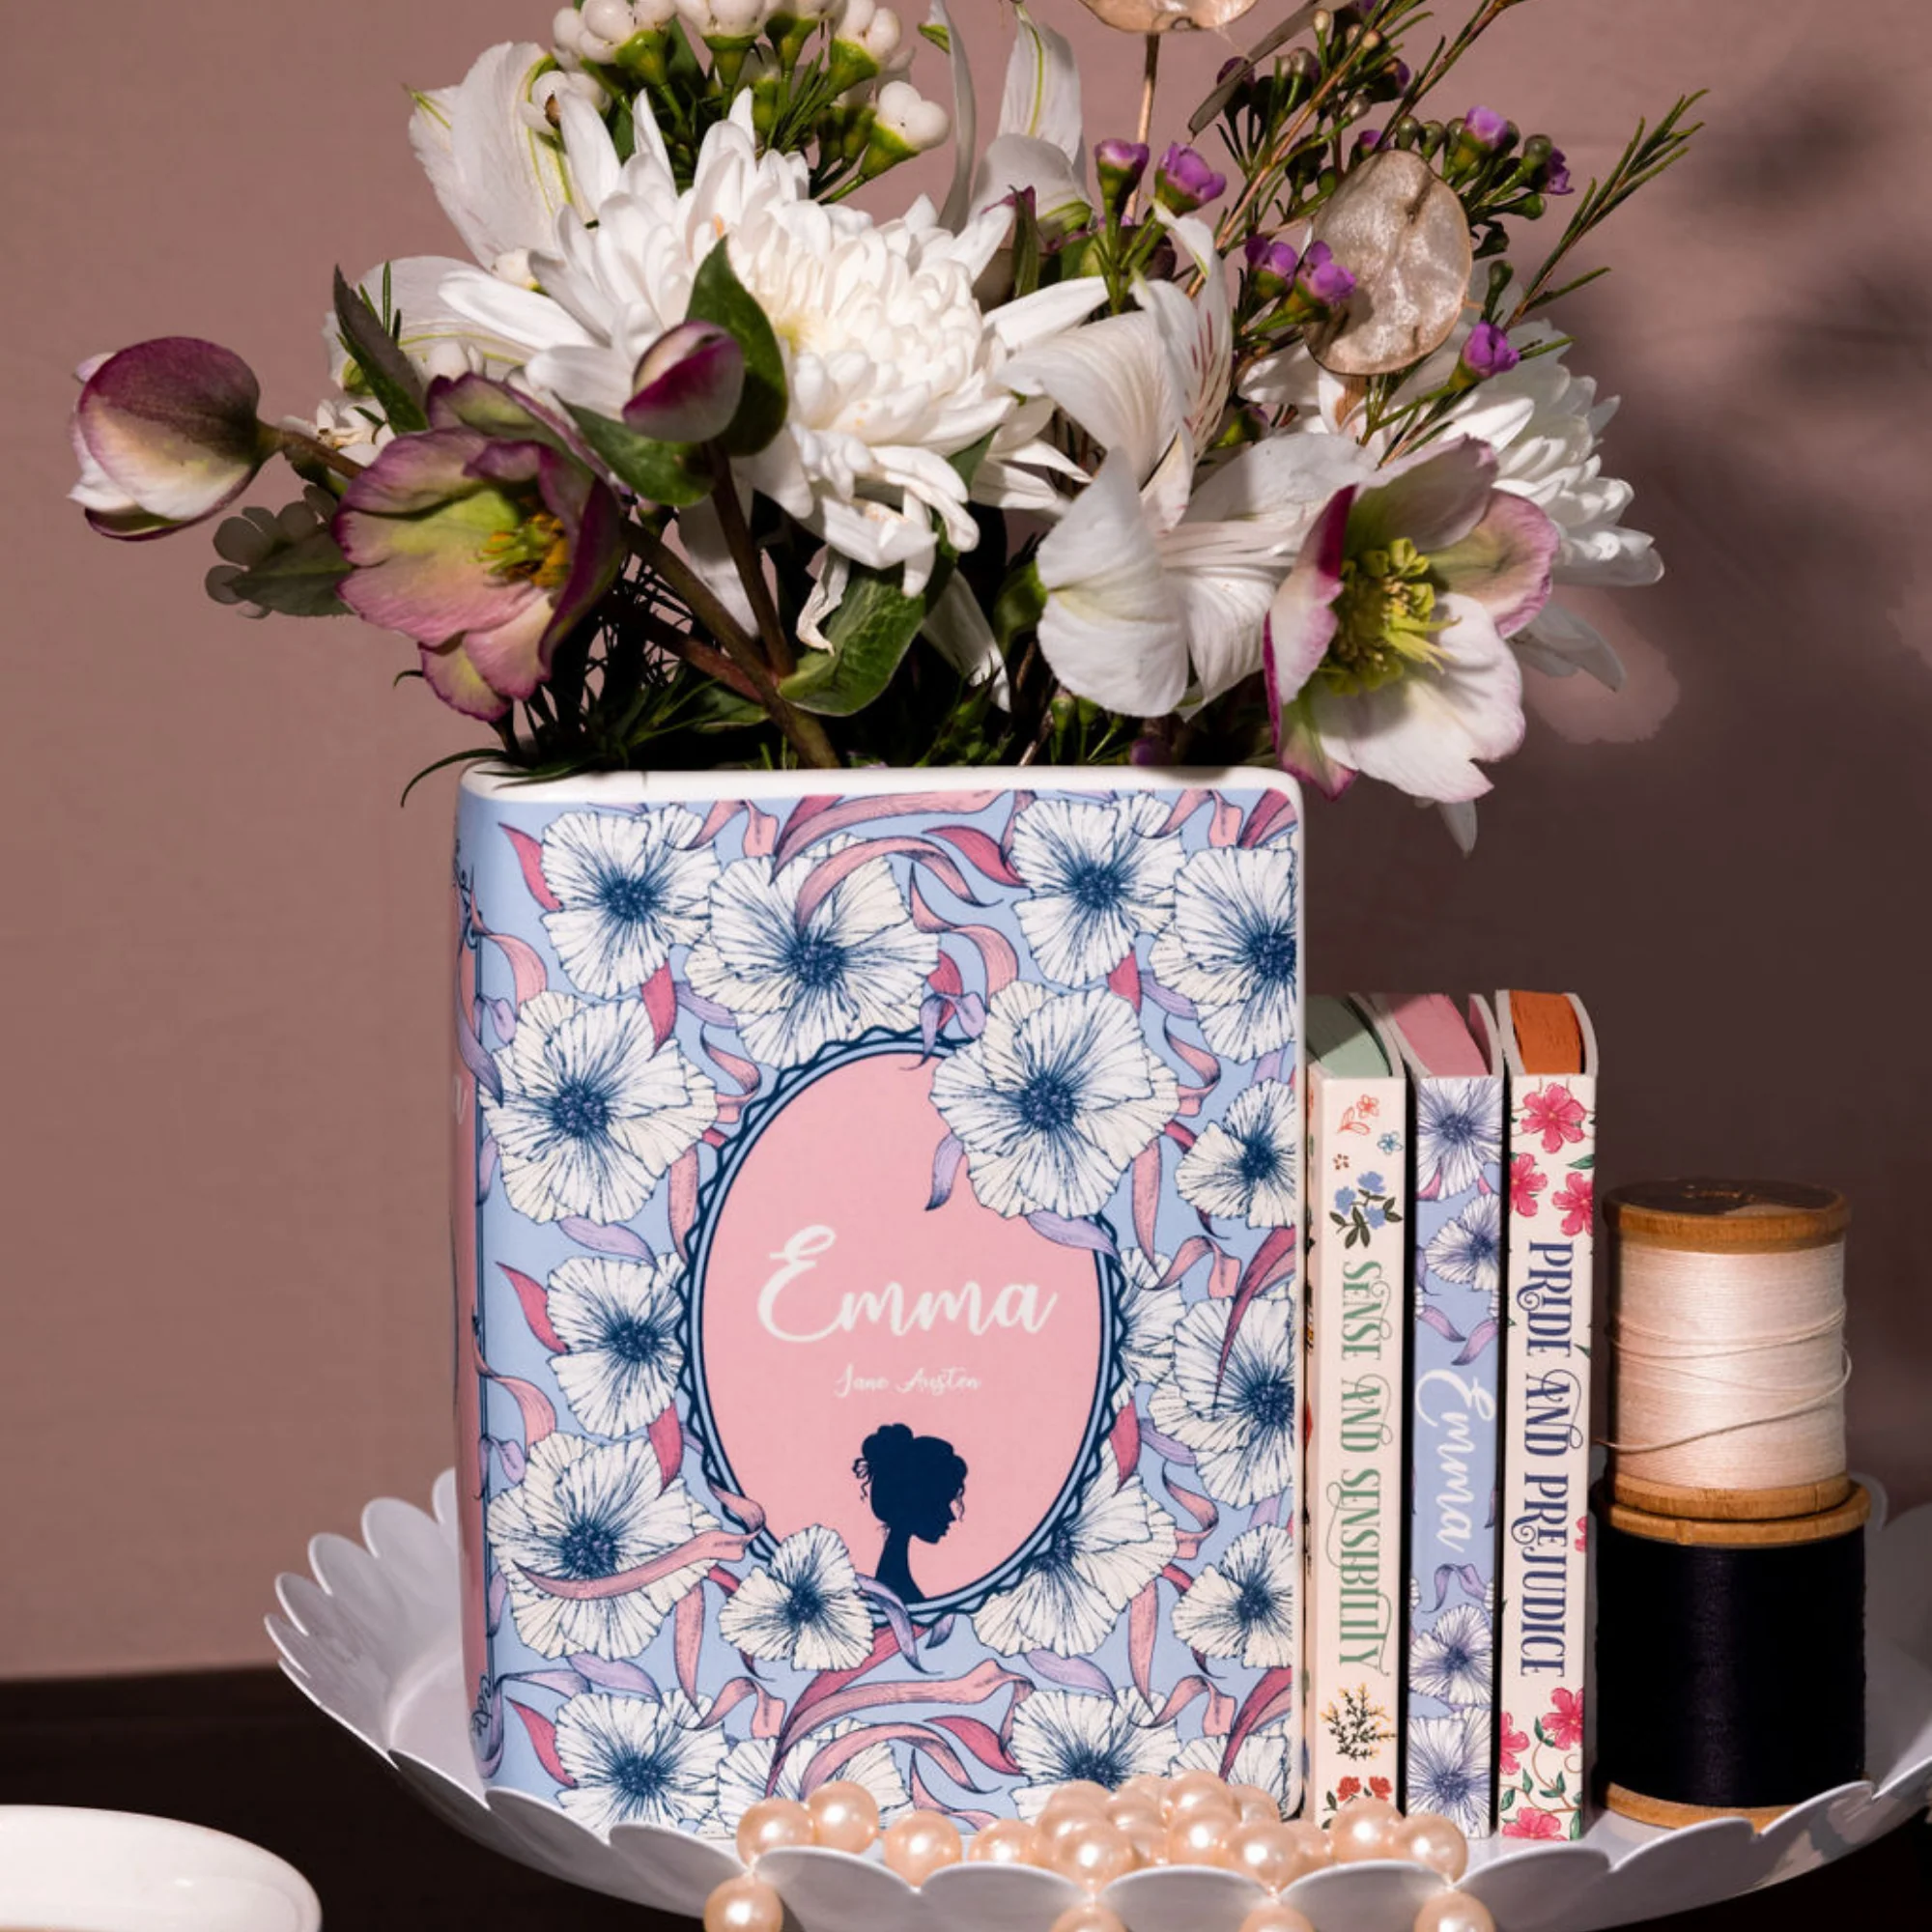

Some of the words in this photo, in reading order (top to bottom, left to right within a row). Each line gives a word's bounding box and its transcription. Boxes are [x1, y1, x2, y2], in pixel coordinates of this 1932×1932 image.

[757, 1224, 1058, 1343] Emma
[1342, 1260, 1394, 1361] SENSE
[1517, 1239, 1575, 1357] PRIDE
[835, 1364, 889, 1398] Jane
[896, 1367, 981, 1396] Austen
[1340, 1374, 1394, 1453] AND
[1523, 1369, 1583, 1457] AND
[1414, 1369, 1496, 1553] Emma
[1325, 1468, 1393, 1678] SENSIBILITY
[1511, 1472, 1571, 1678] PREJUDICE
